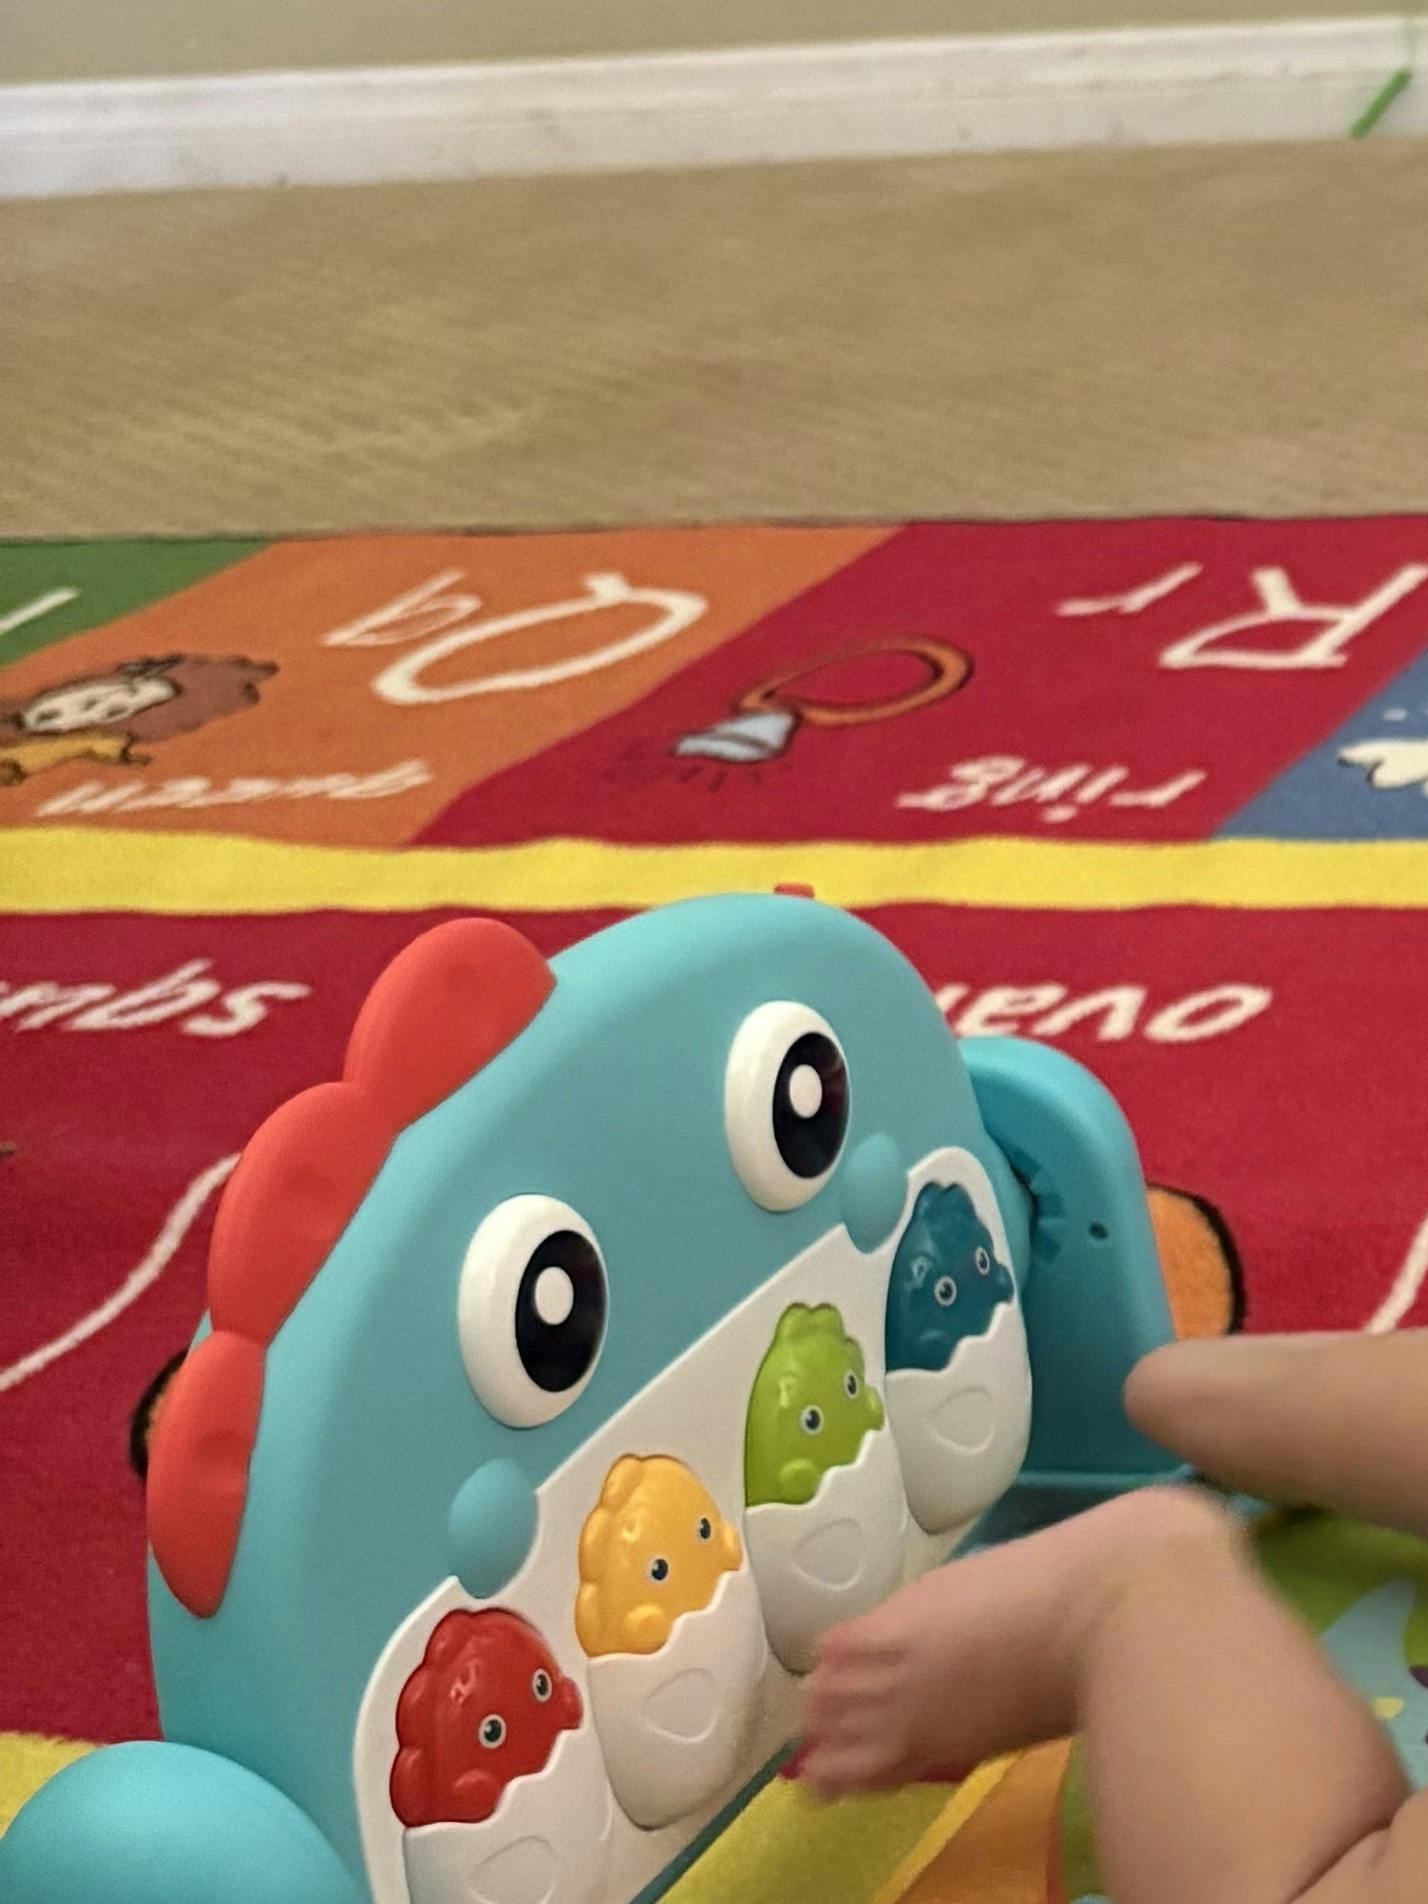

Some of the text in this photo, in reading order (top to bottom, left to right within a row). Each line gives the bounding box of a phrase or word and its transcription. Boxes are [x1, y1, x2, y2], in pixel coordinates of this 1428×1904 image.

[1054, 562, 1202, 618] r
[371, 571, 710, 707] Q
[34, 760, 432, 817] queen
[895, 755, 1207, 824] ring
